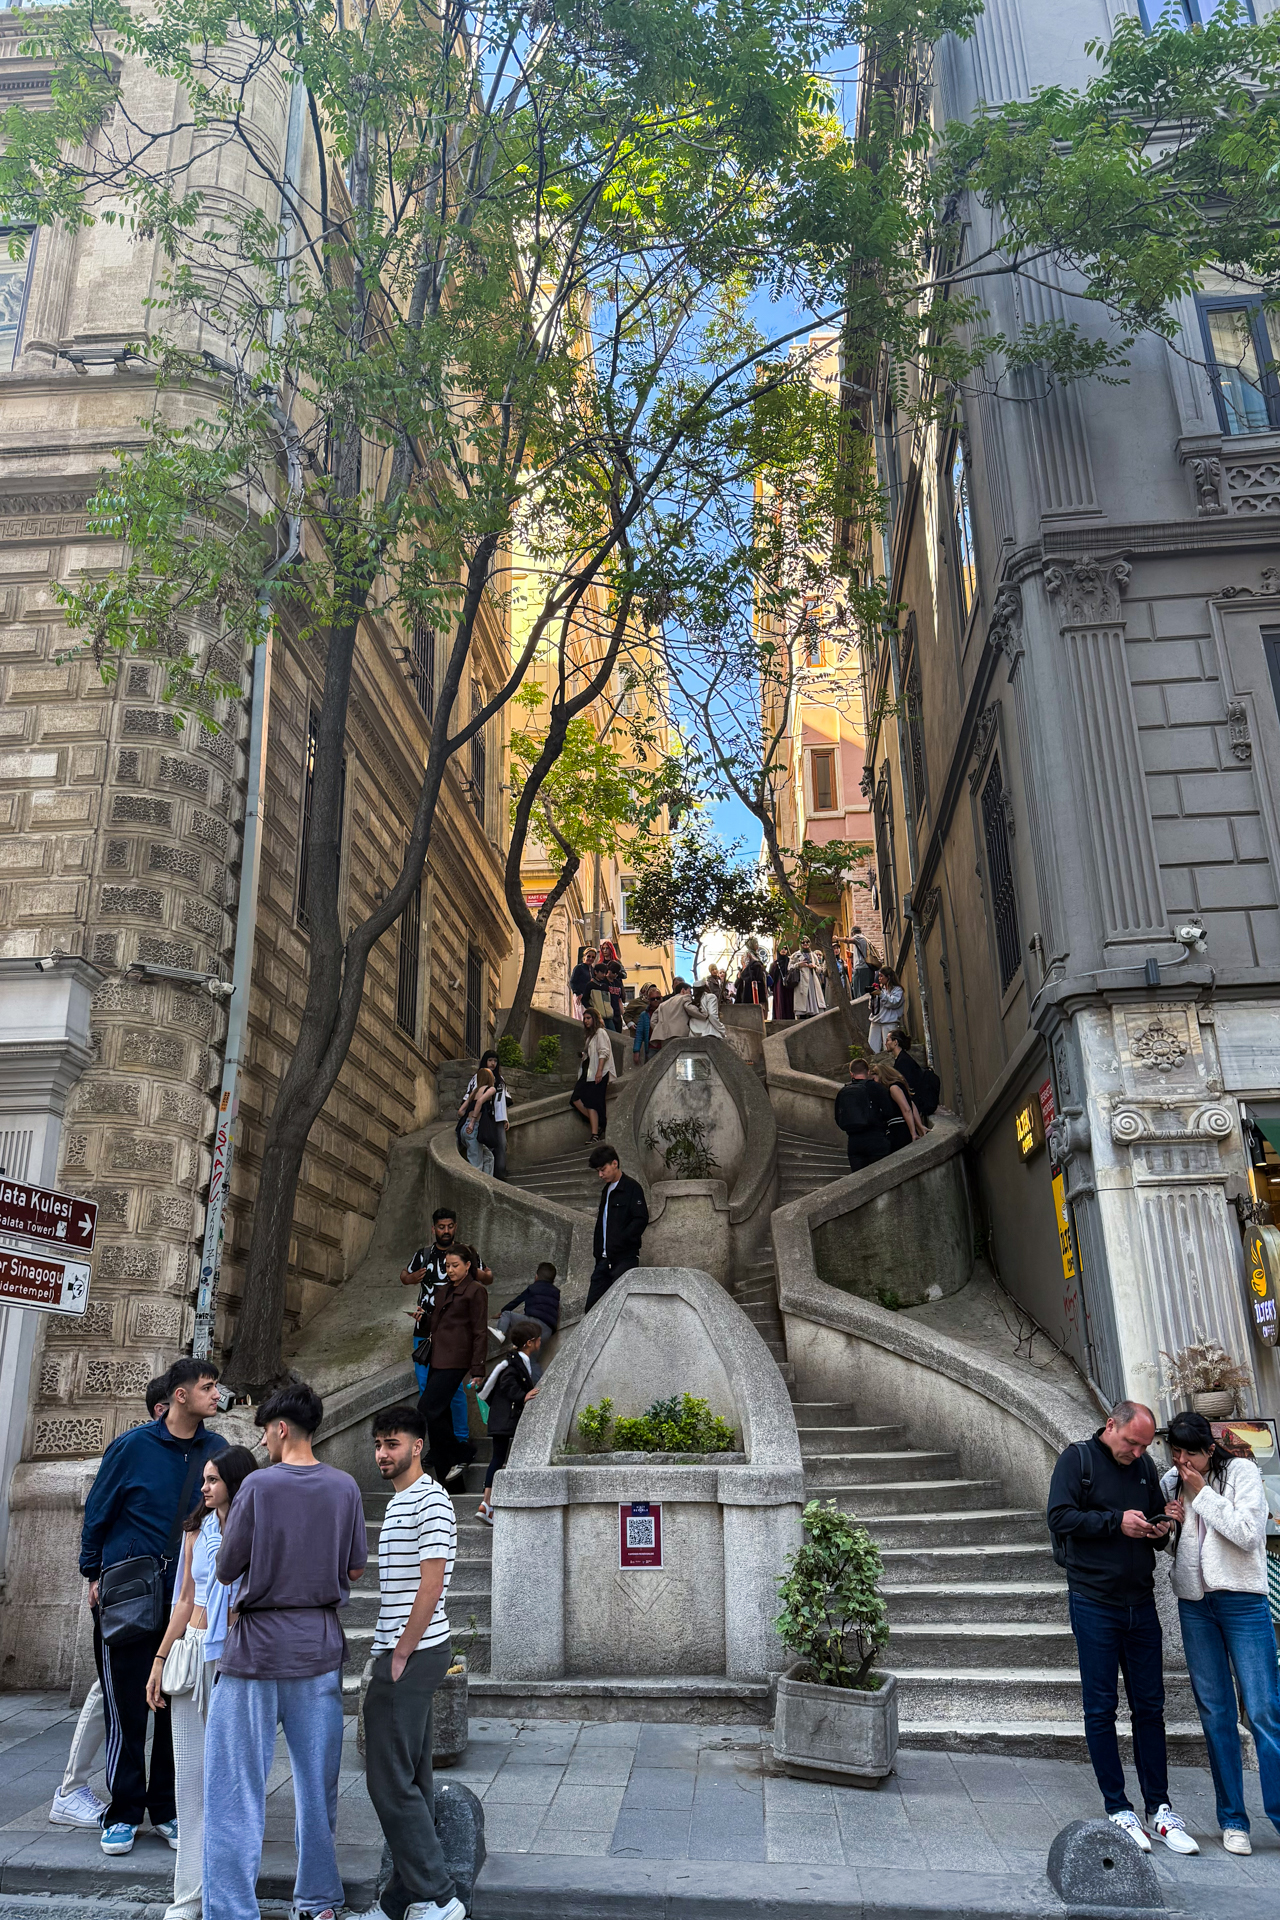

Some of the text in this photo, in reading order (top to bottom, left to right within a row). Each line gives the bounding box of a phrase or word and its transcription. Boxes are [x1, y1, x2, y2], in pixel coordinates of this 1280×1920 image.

[30, 1191, 73, 1218] Kulesi
[27, 1220, 55, 1236] Tower)
[10, 1258, 64, 1287] Sinagogu
[0, 1281, 54, 1300] idertempel)
